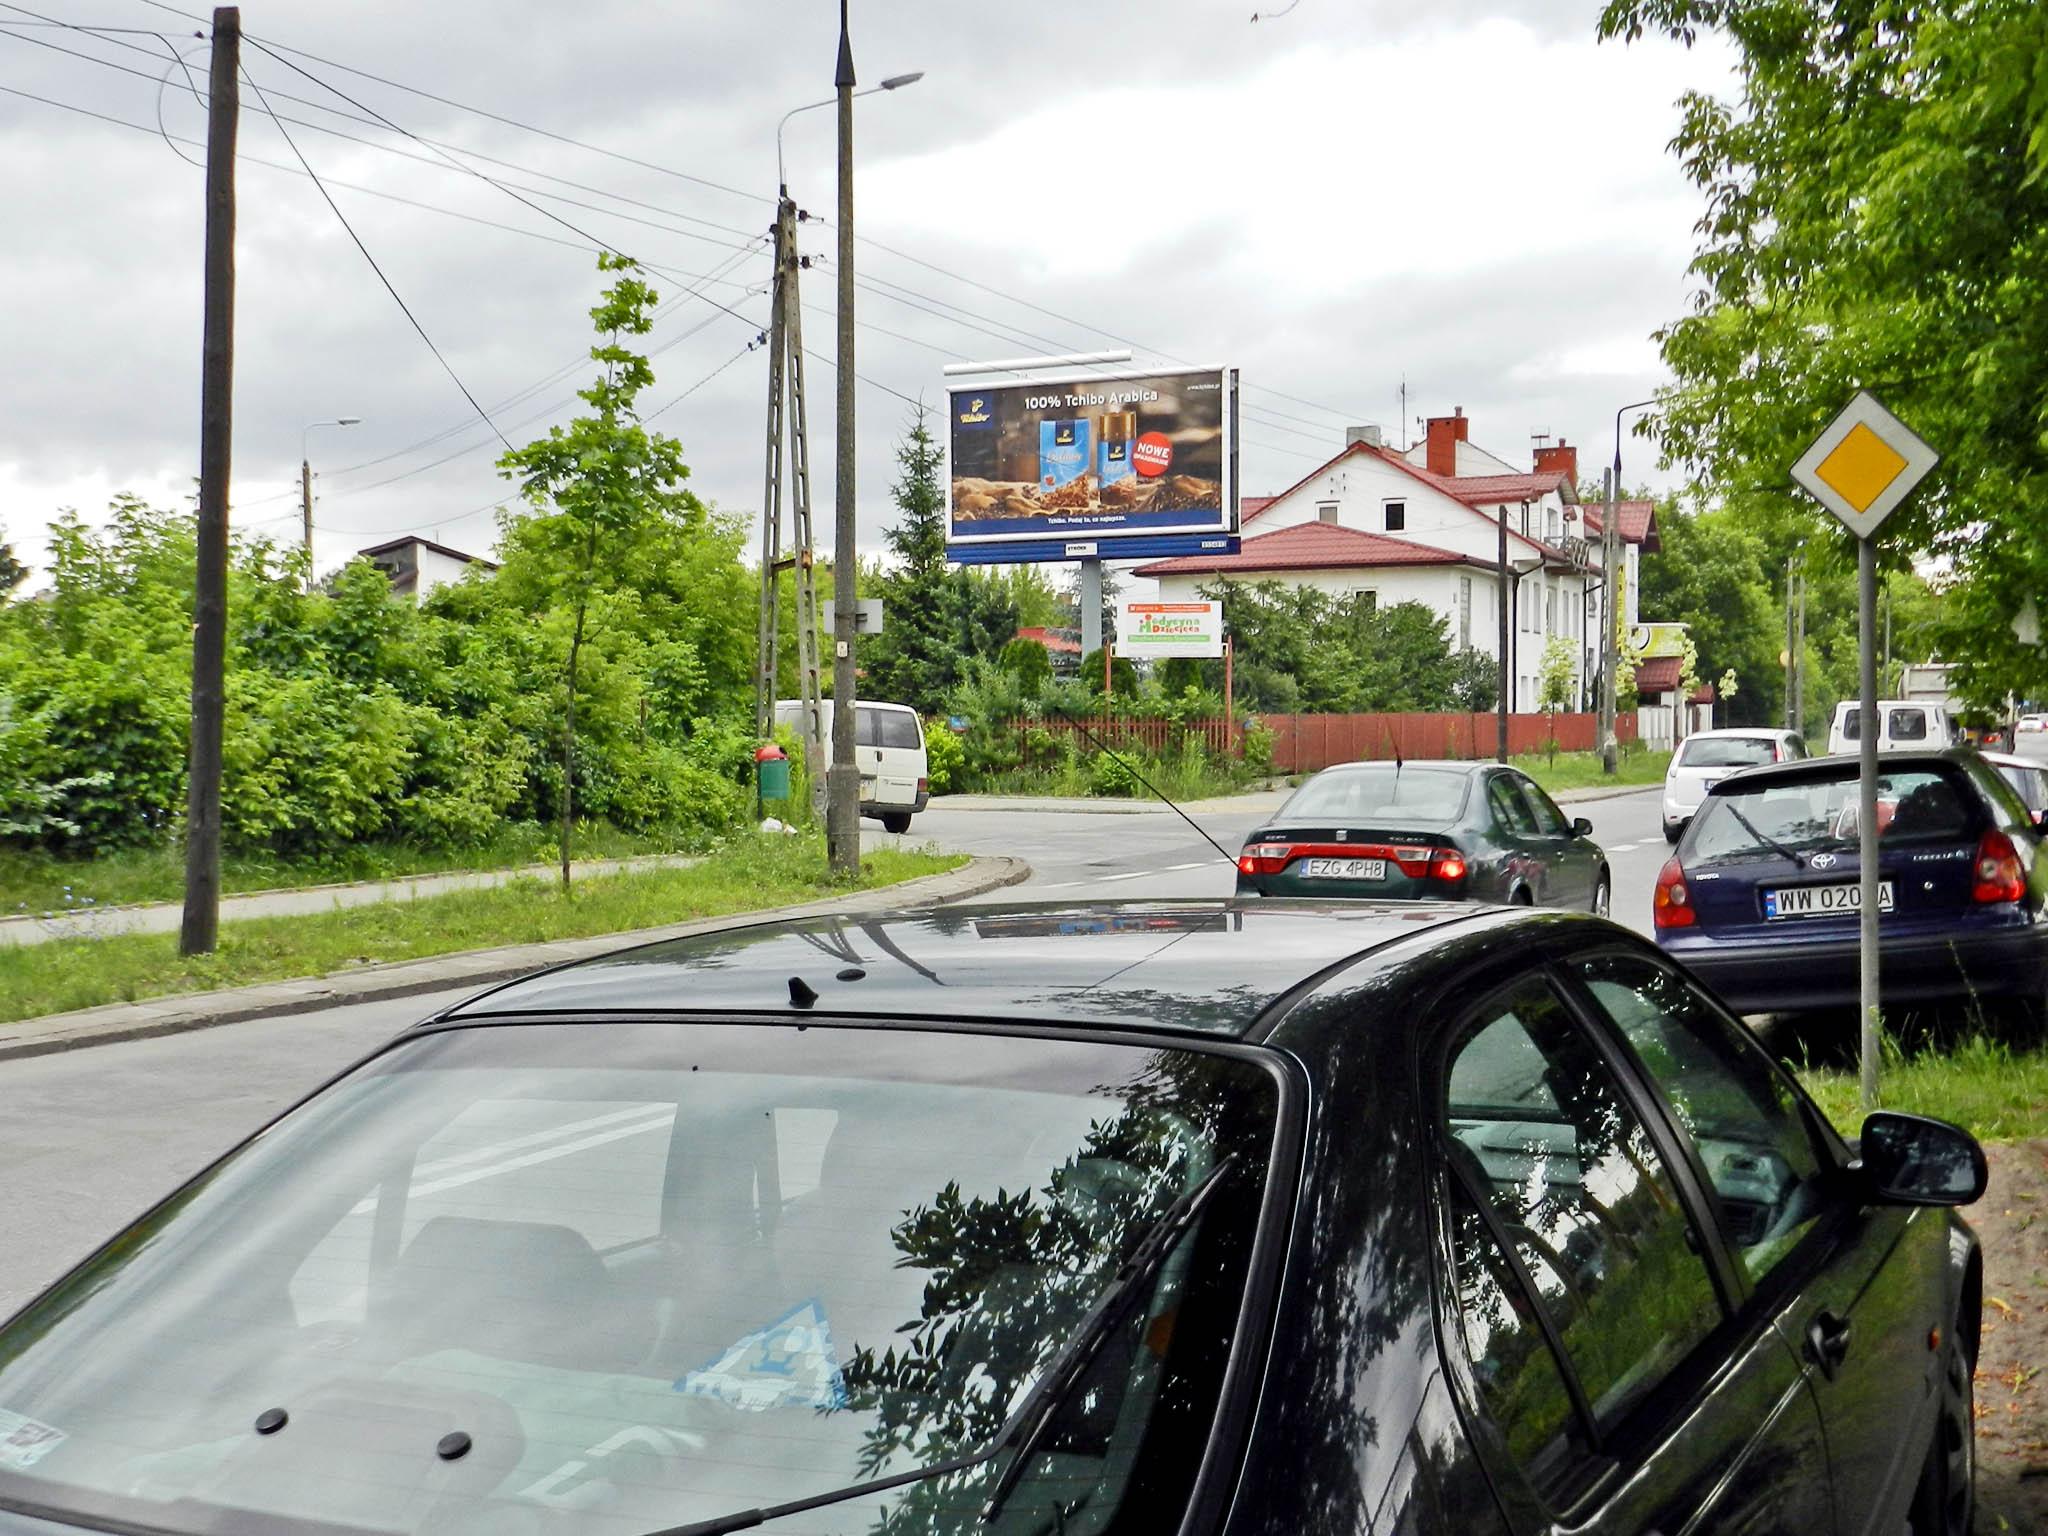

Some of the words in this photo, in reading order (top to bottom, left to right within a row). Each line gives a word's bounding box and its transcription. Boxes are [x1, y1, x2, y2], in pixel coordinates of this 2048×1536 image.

[1025, 396, 1061, 410] 100%
[1065, 394, 1106, 407] Tchibo
[1109, 390, 1159, 405] Arabica
[1137, 442, 1170, 459] NOWE
[1310, 860, 1342, 876] EZG
[1346, 861, 1382, 877] 4PH8
[1780, 889, 1812, 912] WW
[1821, 885, 1891, 909] 020A
